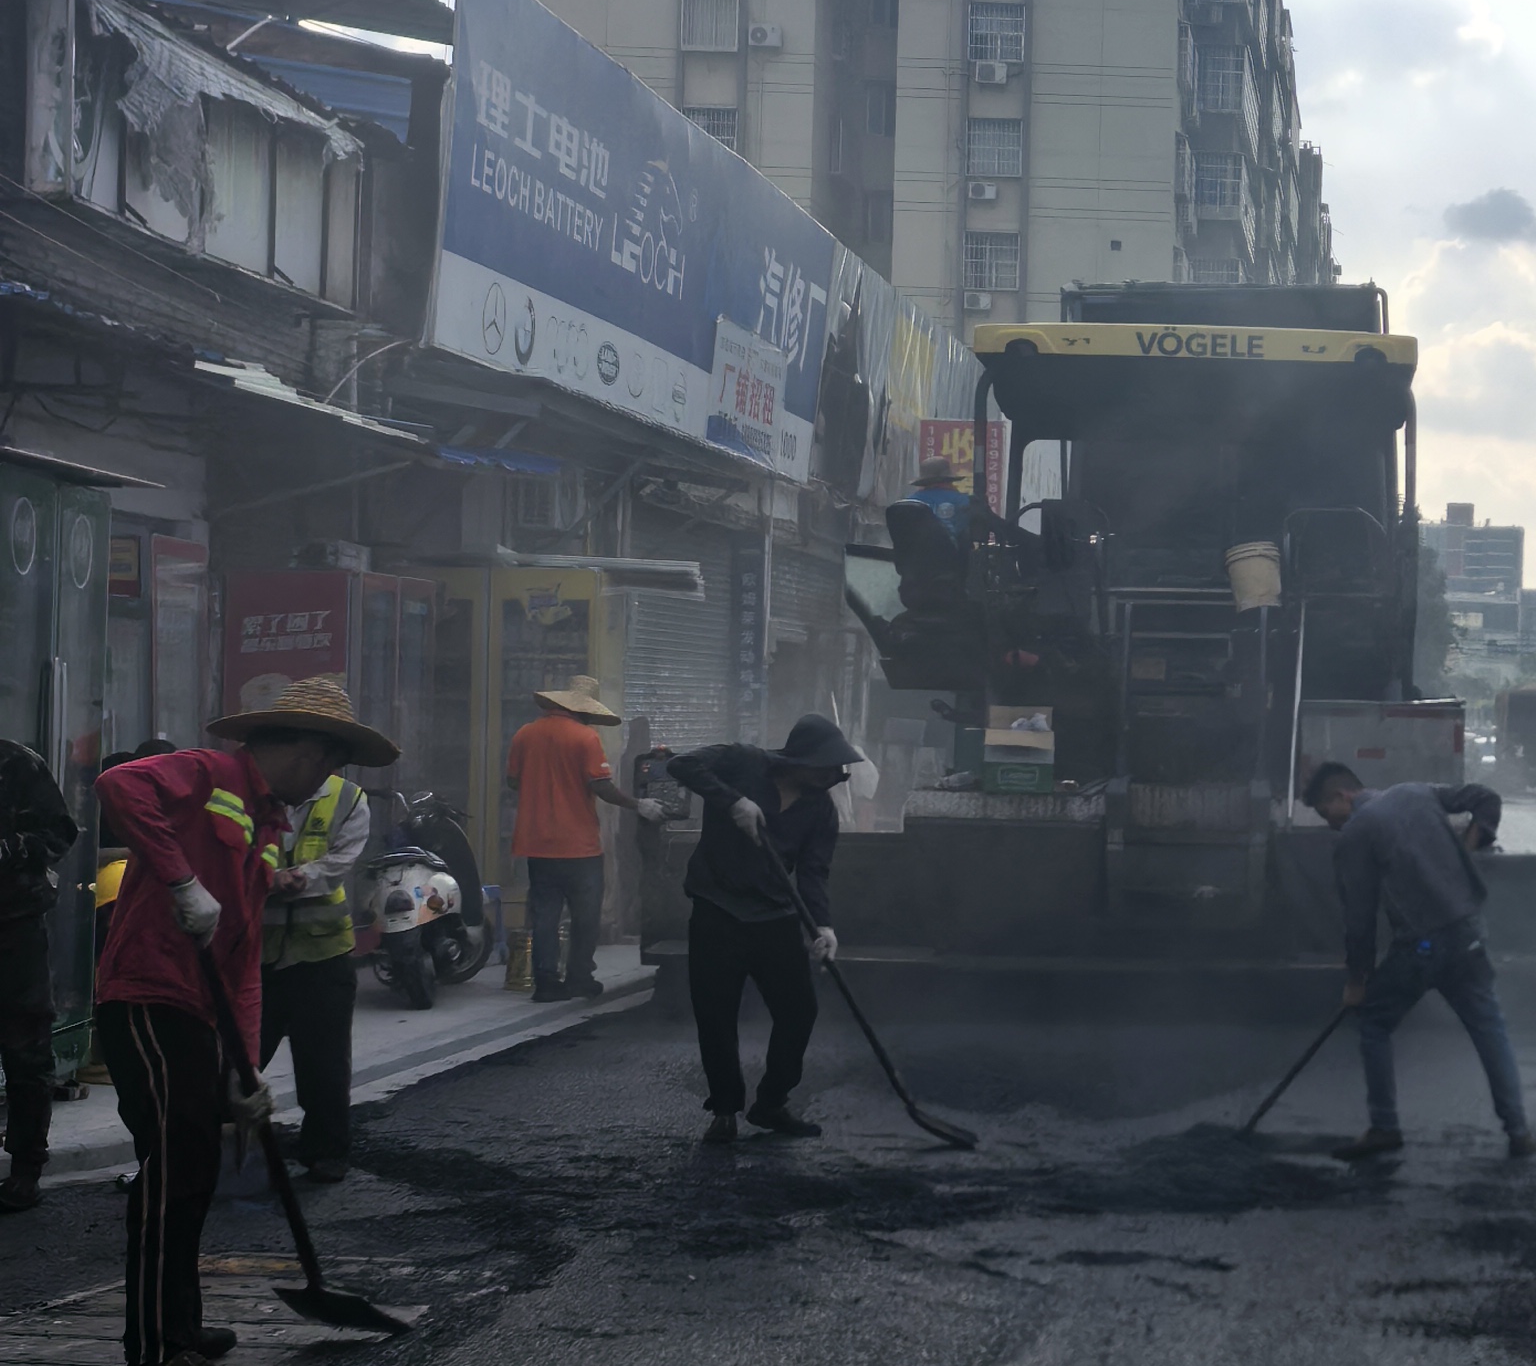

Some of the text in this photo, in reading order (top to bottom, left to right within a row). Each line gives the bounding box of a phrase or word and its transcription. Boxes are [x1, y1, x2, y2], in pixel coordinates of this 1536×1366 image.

[474, 59, 610, 199] 理士电池
[470, 143, 605, 252] LEOCH BATTERY
[757, 247, 828, 373] 汽修厂
[1135, 326, 1265, 359] VÖGELE
